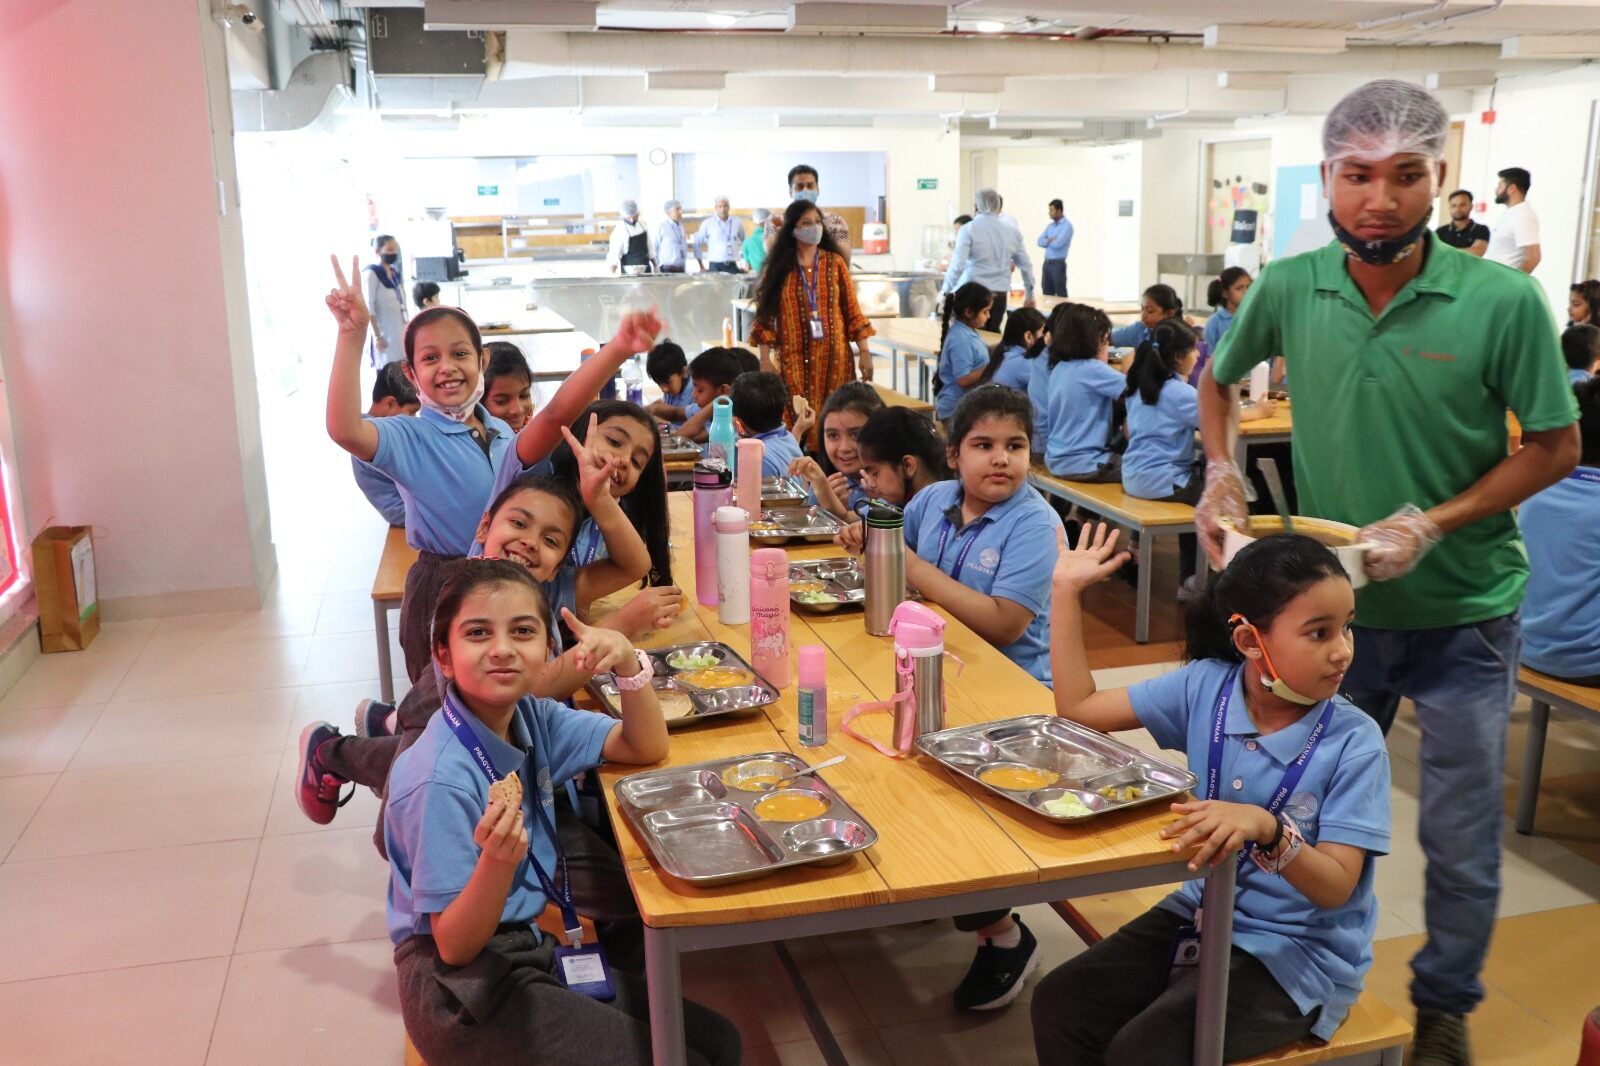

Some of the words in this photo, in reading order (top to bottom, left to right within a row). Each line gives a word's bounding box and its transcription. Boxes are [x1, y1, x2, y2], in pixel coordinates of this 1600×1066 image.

[1213, 696, 1227, 743] PRAGYANAM
[473, 746, 498, 783] PRAGYANA
[1296, 722, 1324, 766] PRAGYANAM
